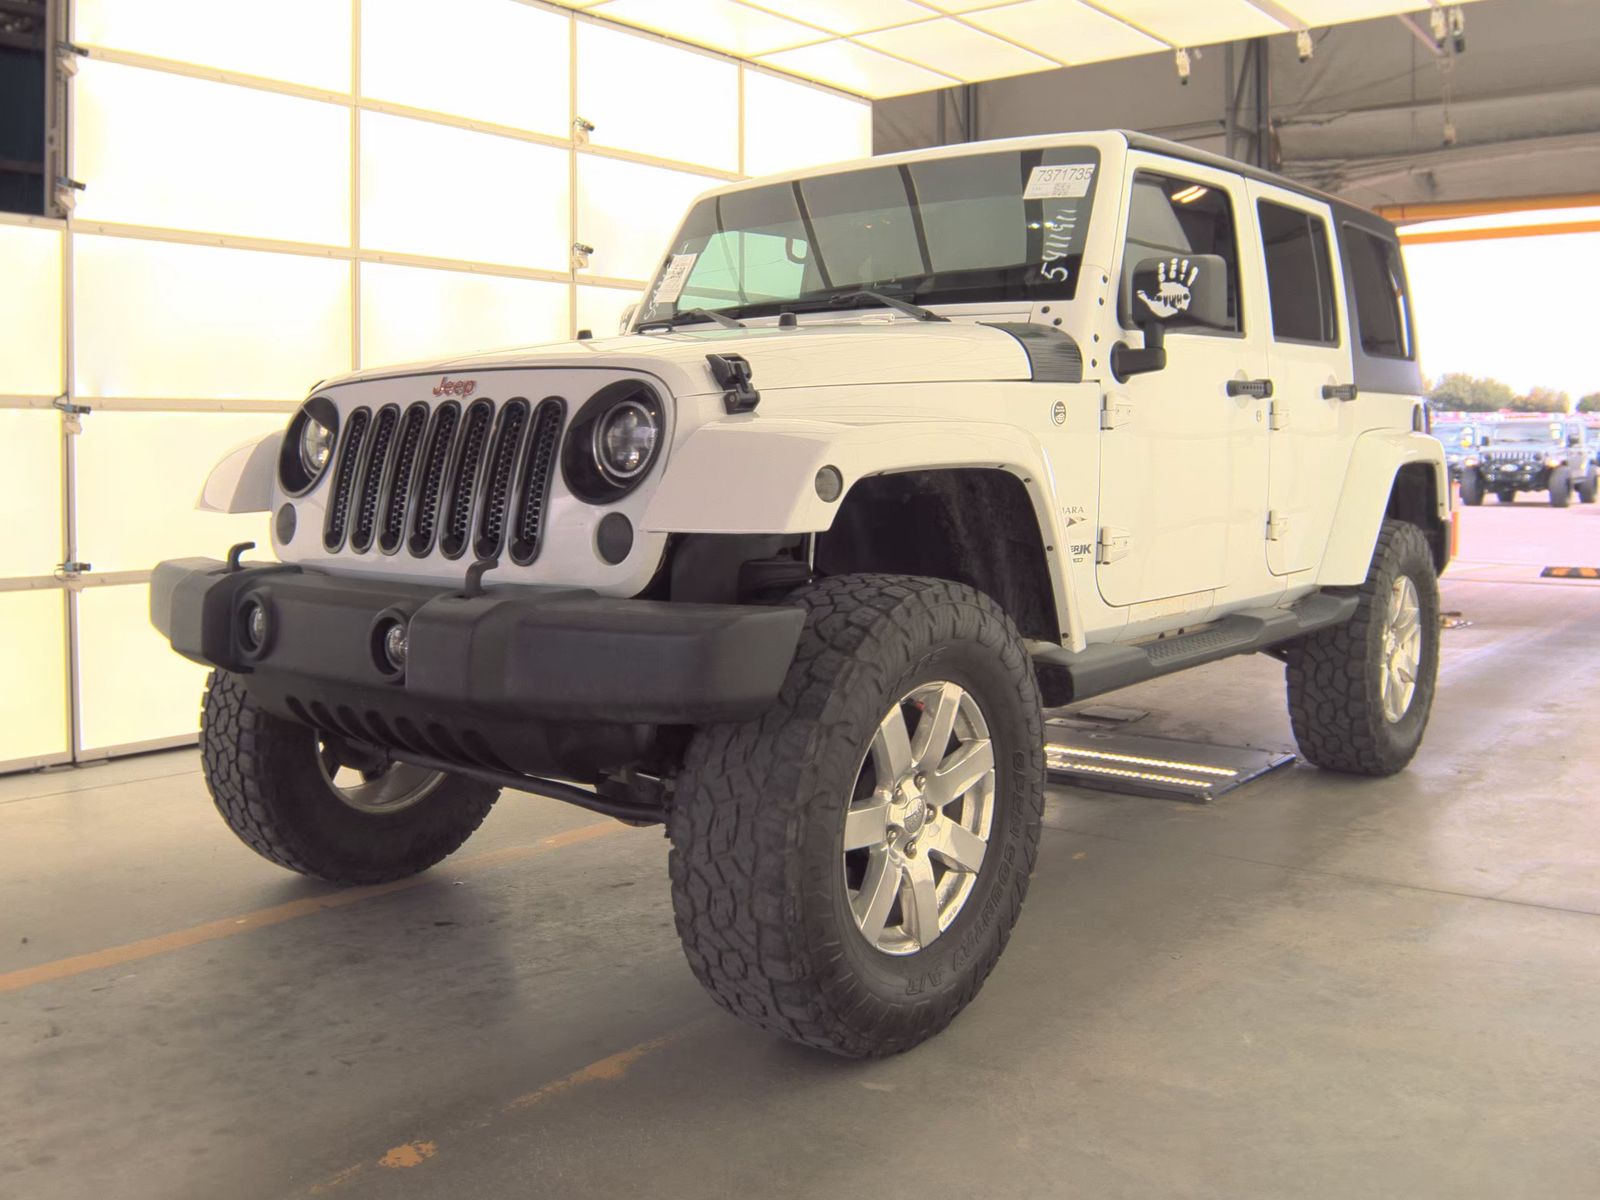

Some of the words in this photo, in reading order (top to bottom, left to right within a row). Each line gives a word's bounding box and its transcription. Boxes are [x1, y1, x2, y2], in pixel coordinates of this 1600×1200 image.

[1037, 168, 1093, 182] 7371735
[433, 376, 476, 399] Jeep
[1009, 751, 1025, 839] OPEN
